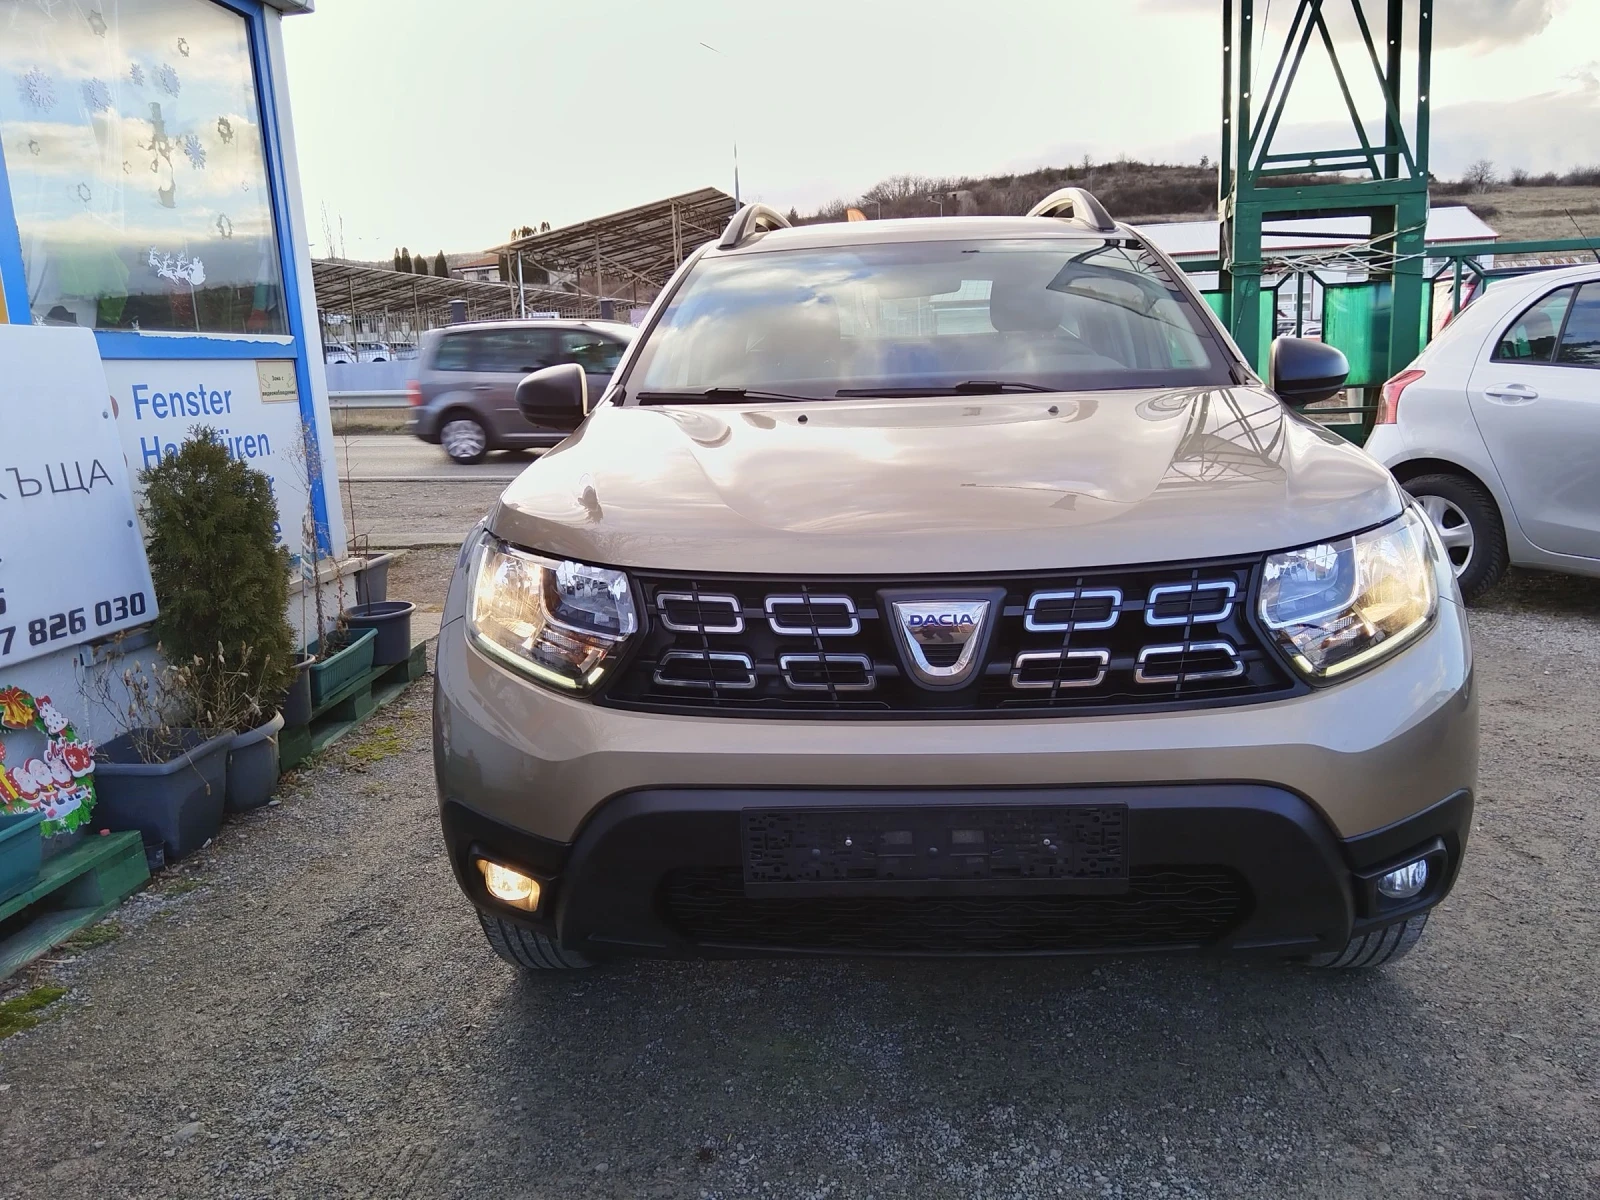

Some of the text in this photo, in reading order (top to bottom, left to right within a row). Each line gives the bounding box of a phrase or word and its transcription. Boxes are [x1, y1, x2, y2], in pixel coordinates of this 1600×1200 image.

[132, 383, 232, 420] Fenster
[0, 459, 114, 499] ЪЩА
[28, 607, 86, 646] 826
[94, 591, 146, 627] 030
[909, 613, 974, 626] DACIA
